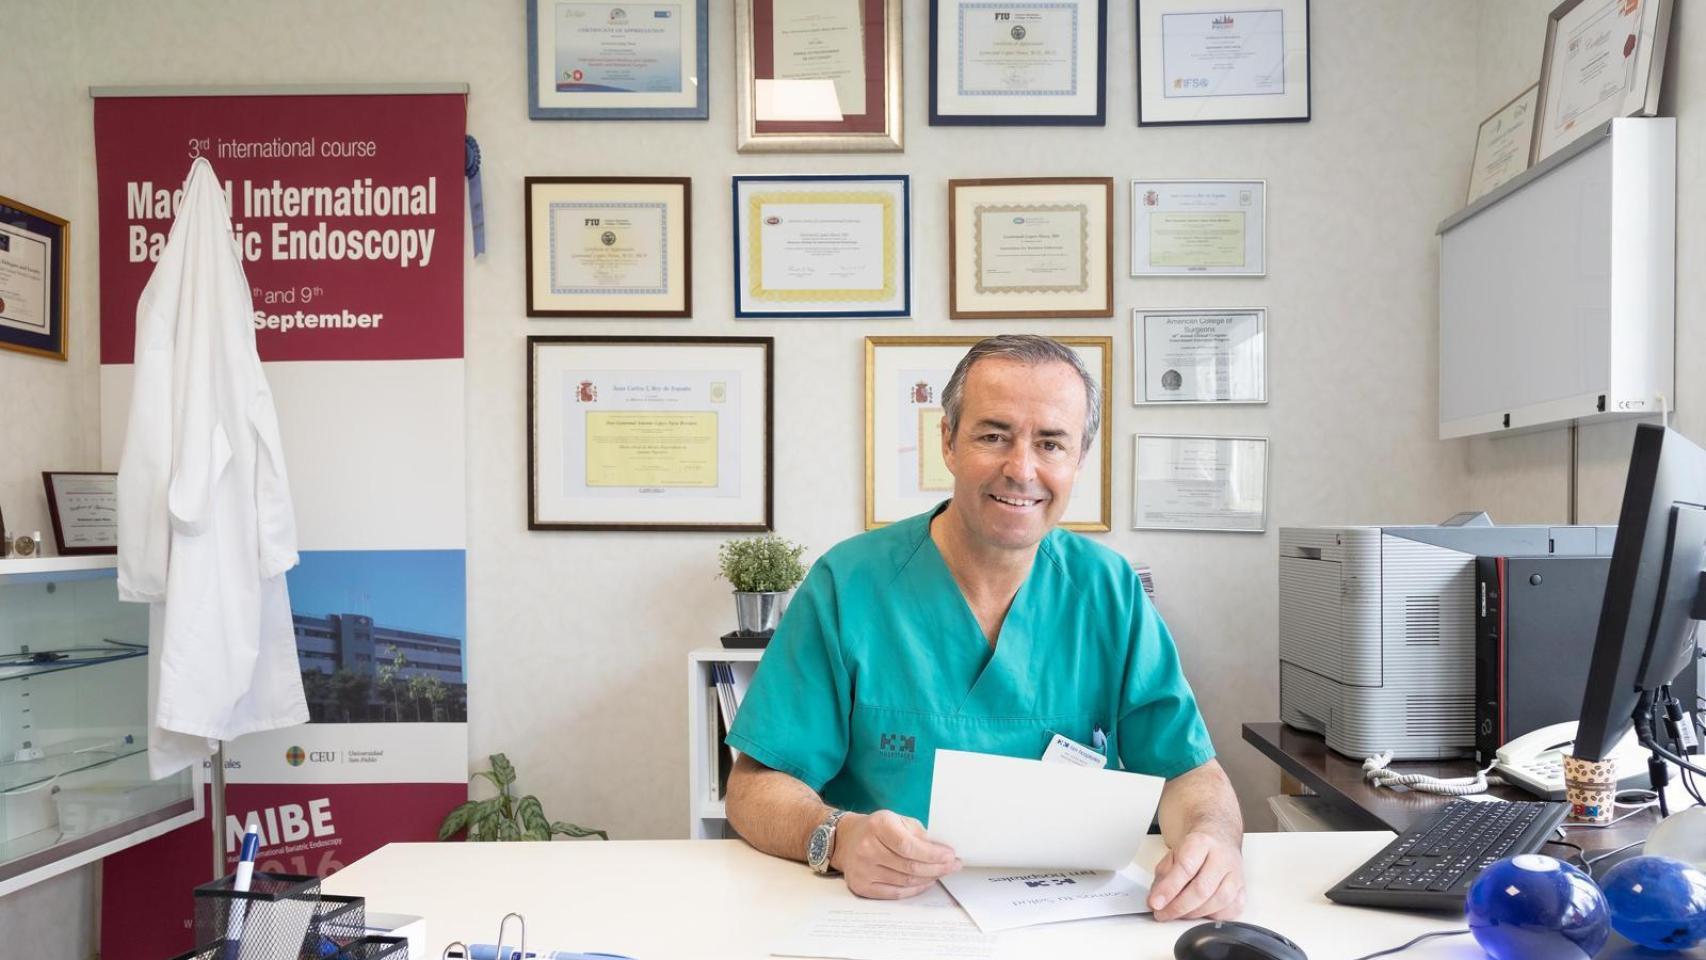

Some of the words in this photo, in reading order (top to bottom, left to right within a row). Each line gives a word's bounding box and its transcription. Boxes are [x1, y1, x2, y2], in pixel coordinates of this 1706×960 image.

[218, 137, 315, 159] international
[321, 140, 376, 157] course
[243, 177, 436, 219] International
[271, 222, 436, 267] Endoscopy
[264, 287, 295, 304] and
[300, 287, 324, 304] 9th
[253, 309, 383, 332] September
[309, 751, 335, 763] CEU
[225, 797, 336, 854] MIBE
[309, 837, 343, 849] Endoscopy
[987, 871, 1067, 883] hospitales
